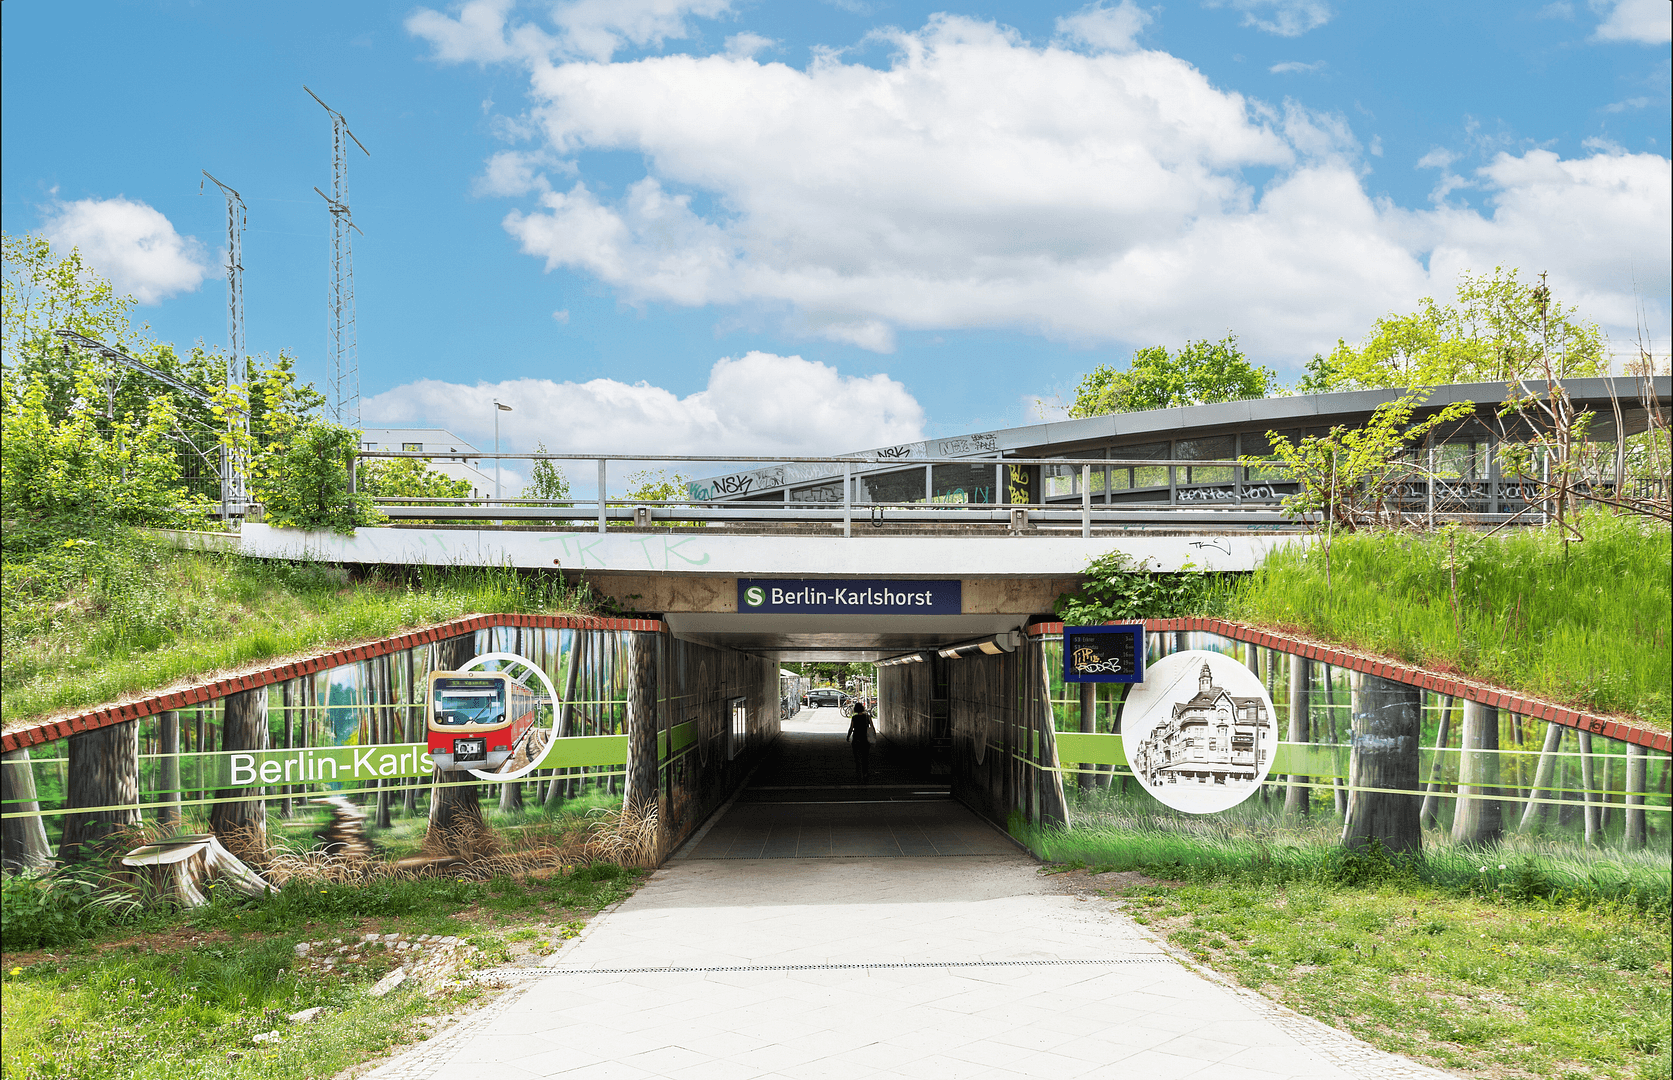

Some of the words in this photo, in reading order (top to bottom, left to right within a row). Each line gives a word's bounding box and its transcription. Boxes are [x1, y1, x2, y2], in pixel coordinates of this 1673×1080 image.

[713, 475, 753, 495] NSK
[771, 586, 933, 606] Berlin-Karlshorst
[230, 746, 434, 786] Berlin-Karls
